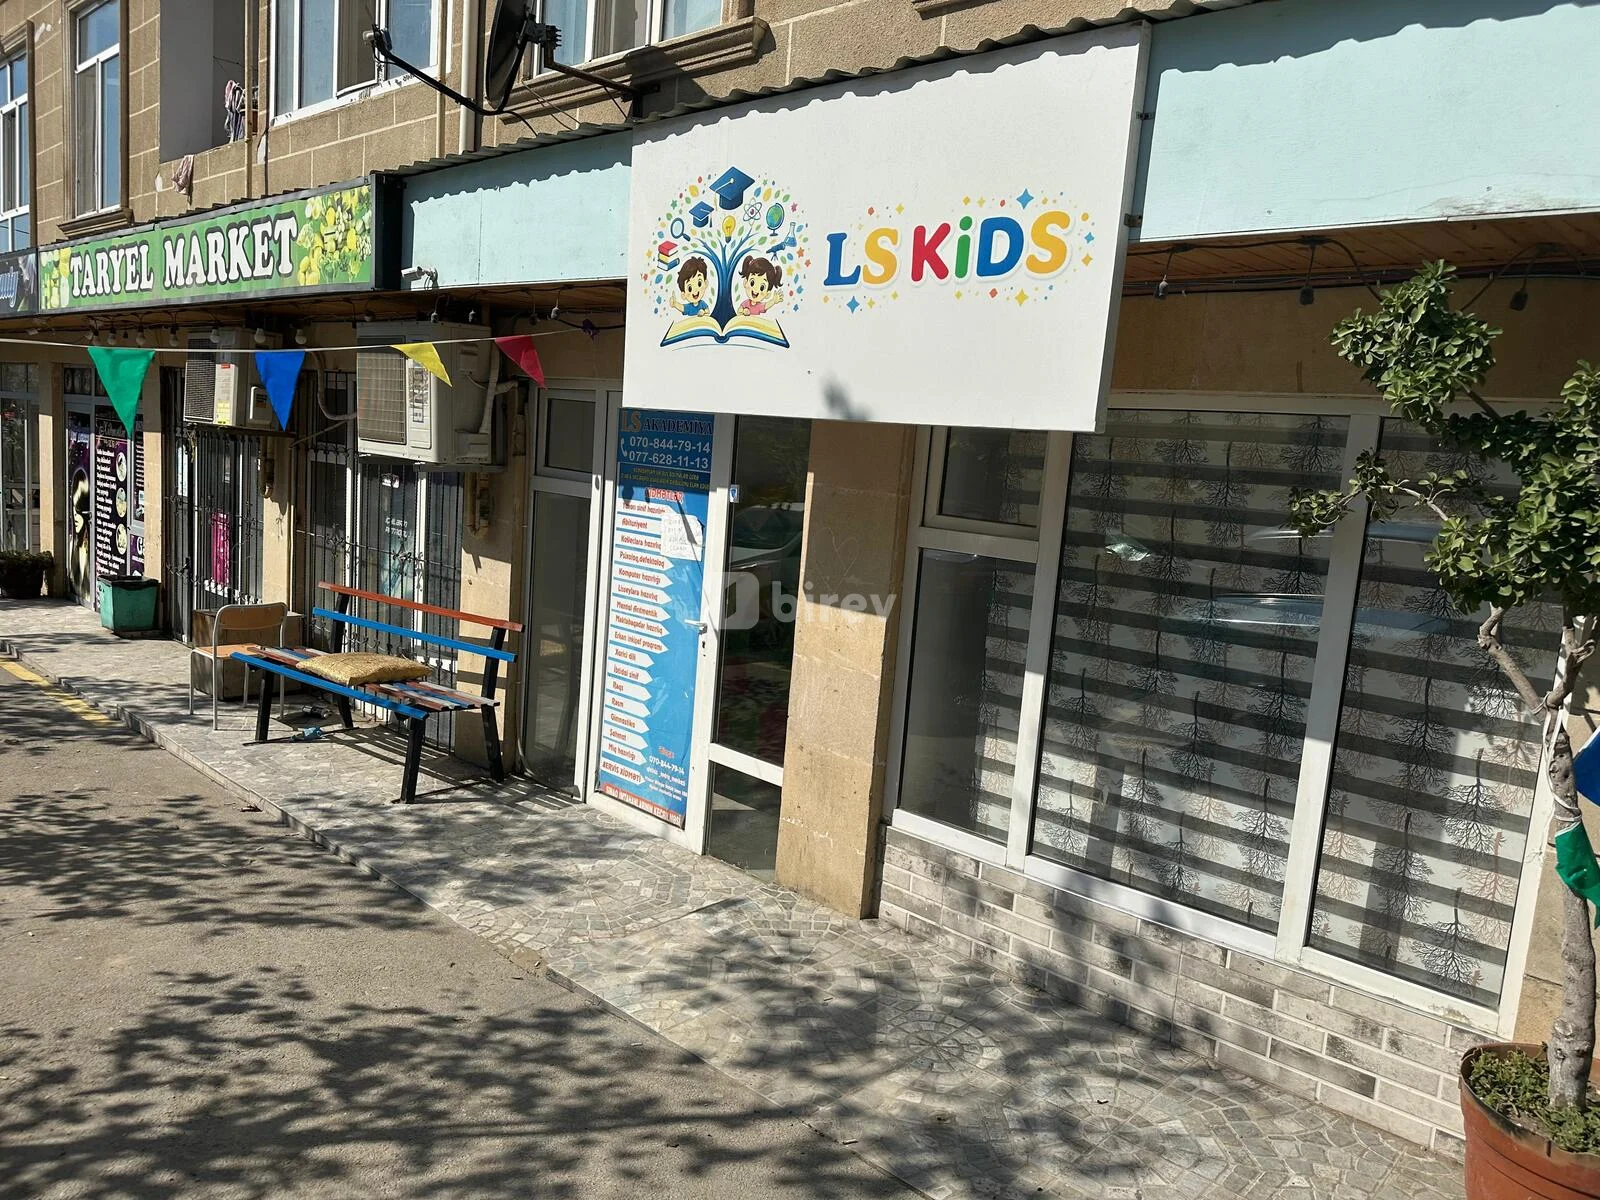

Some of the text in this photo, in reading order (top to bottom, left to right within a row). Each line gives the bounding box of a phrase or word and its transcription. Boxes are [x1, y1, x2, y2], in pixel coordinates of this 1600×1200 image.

[69, 243, 155, 298] TARYEL
[163, 214, 299, 289] MARKET
[823, 227, 899, 286] LS
[629, 451, 709, 469] 077-628-11-13
[630, 436, 711, 454] 070-844-79-14
